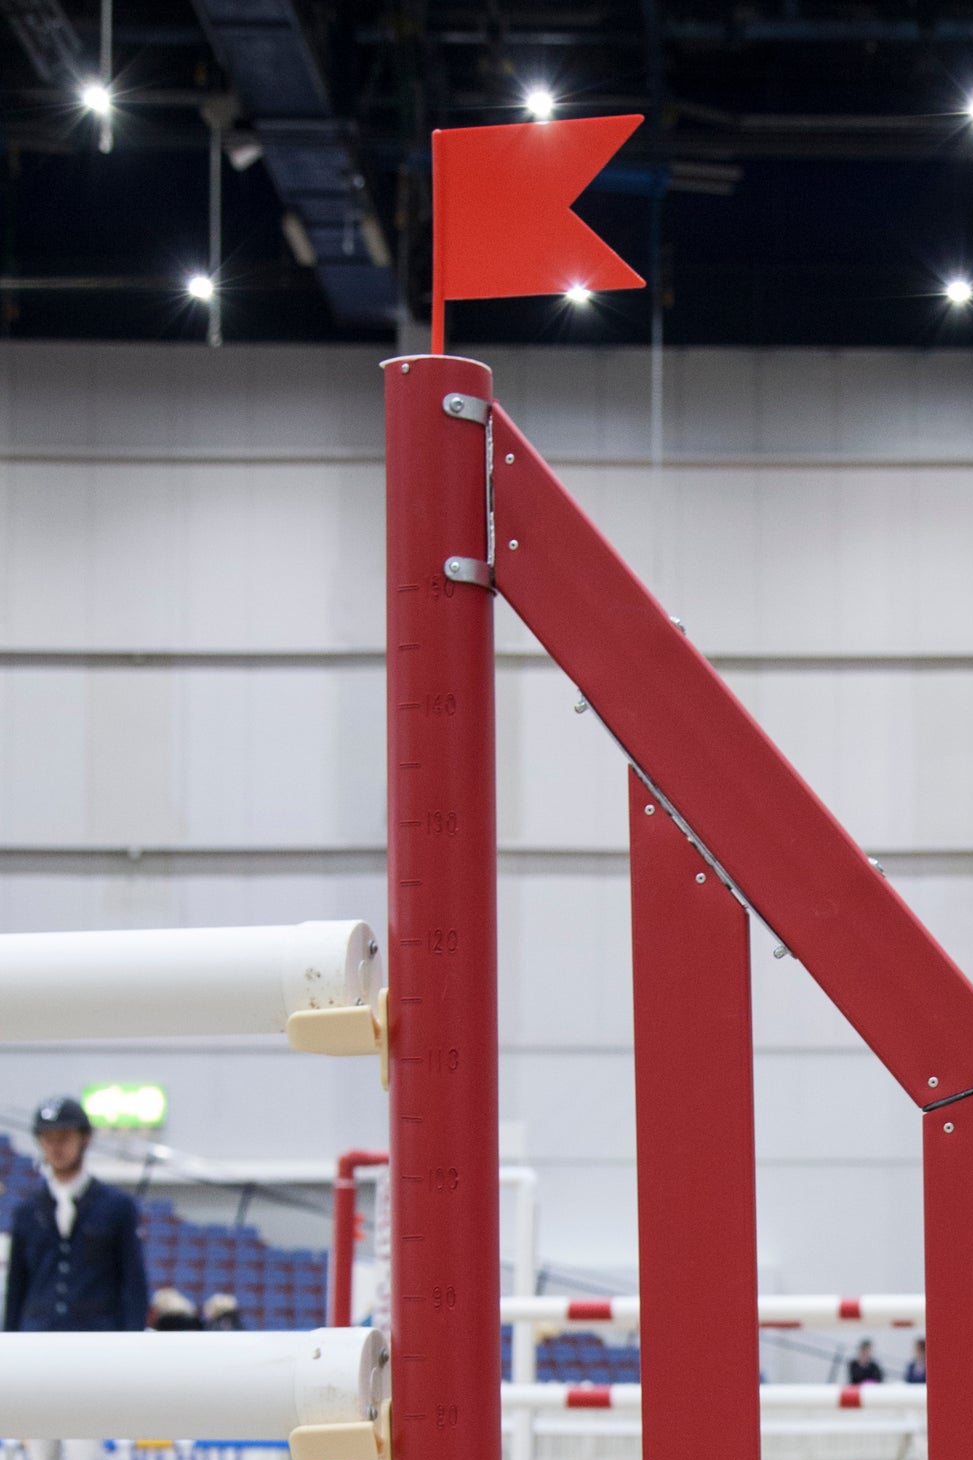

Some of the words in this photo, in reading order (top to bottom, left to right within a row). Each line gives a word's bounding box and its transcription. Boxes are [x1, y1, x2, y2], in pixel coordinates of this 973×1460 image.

[427, 810, 457, 836] 130
[428, 929, 458, 955] 120
[428, 1048, 459, 1073] 110
